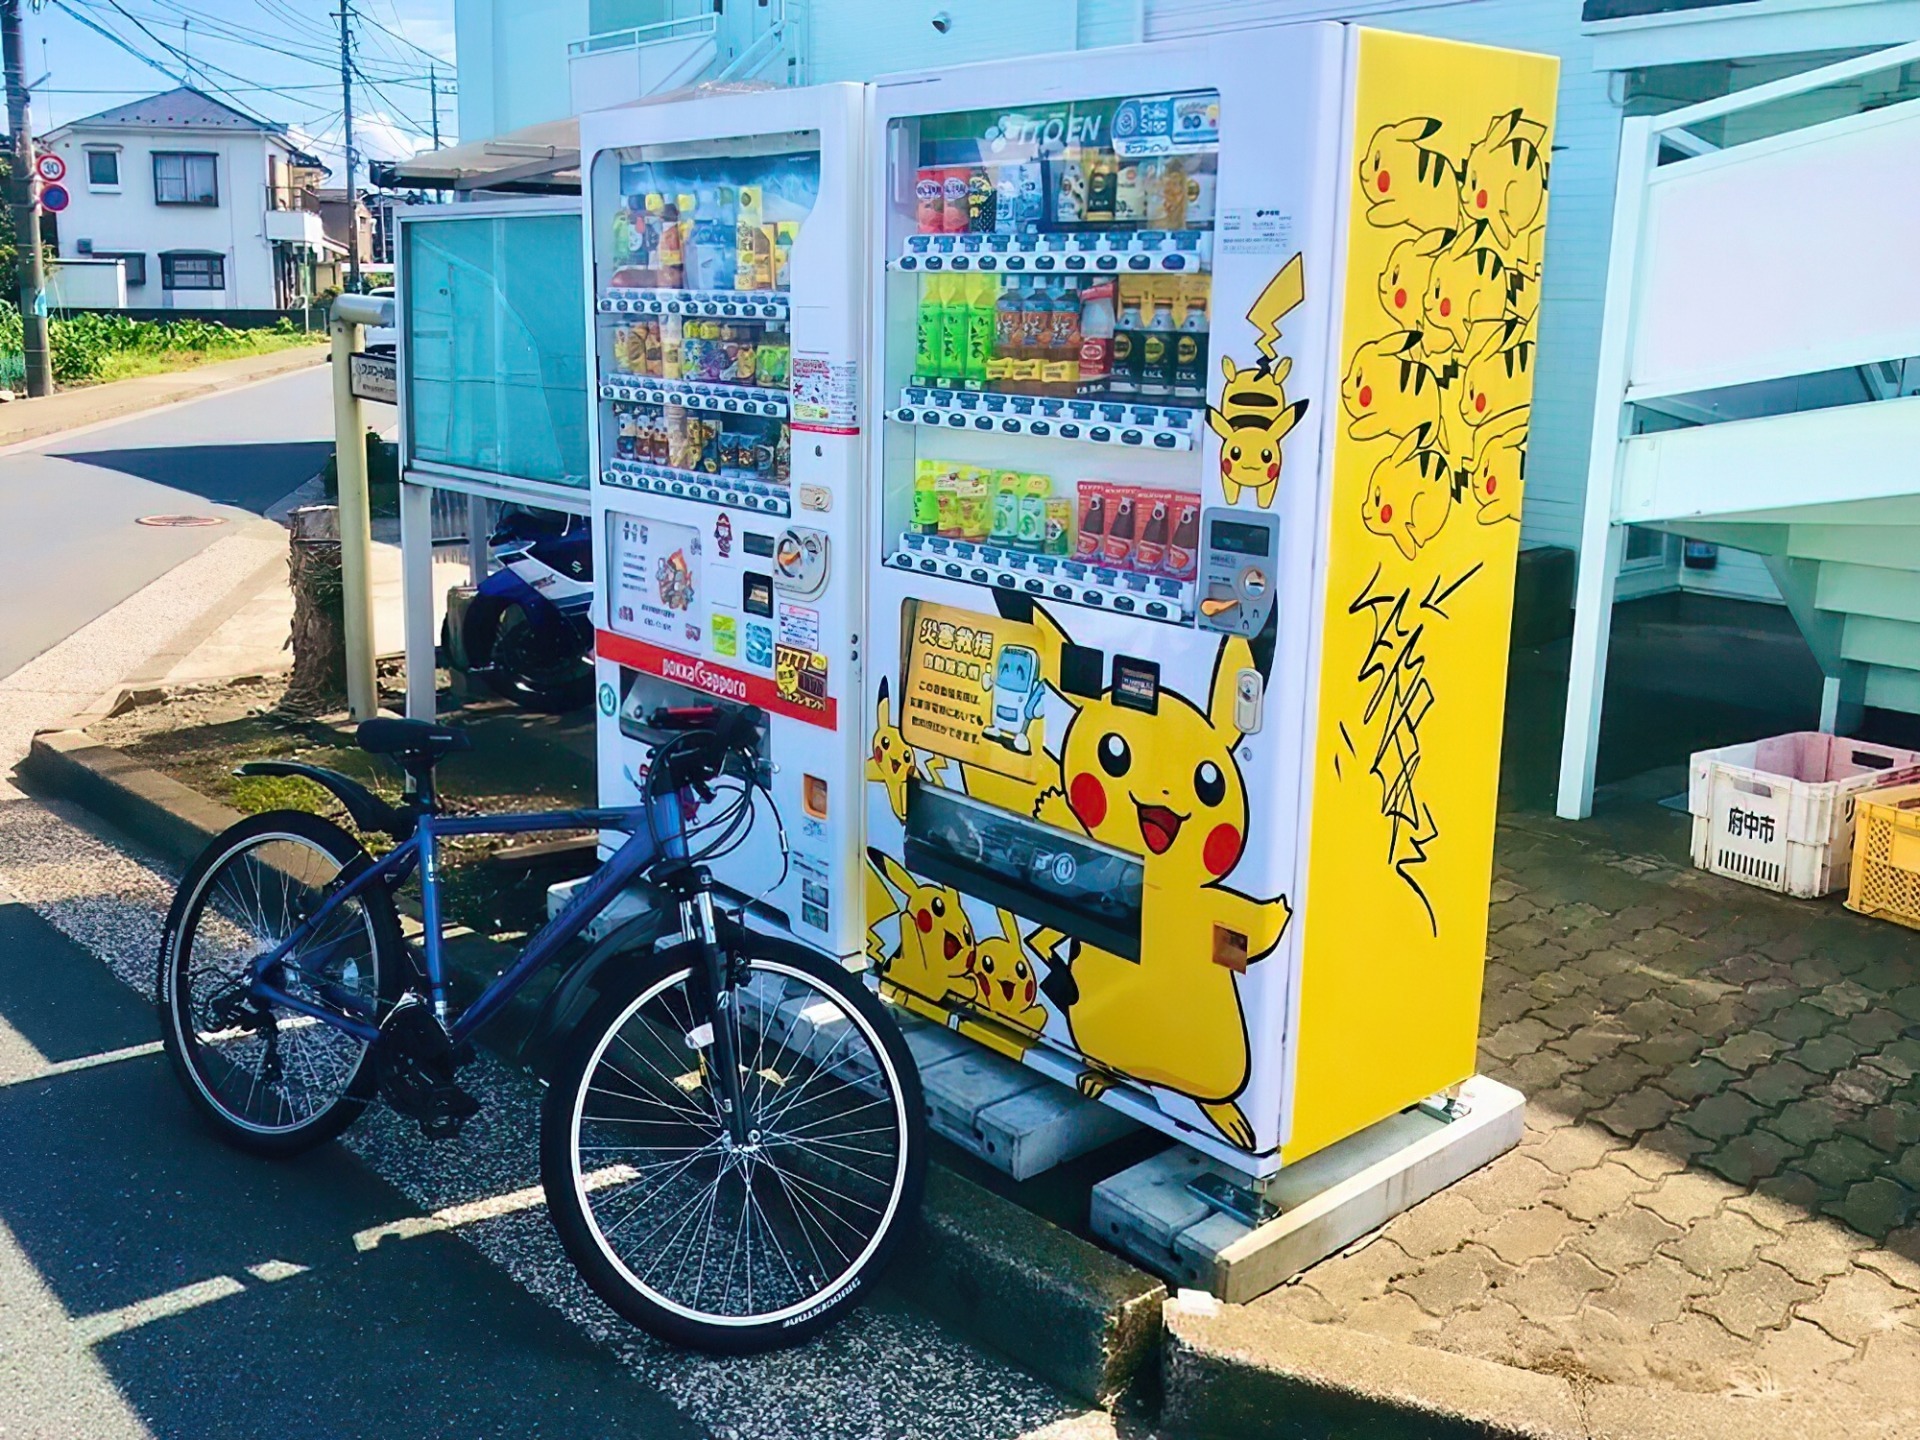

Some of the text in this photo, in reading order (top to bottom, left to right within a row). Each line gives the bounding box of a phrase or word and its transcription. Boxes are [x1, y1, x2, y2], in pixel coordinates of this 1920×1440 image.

[43, 161, 60, 175] 30
[920, 618, 994, 660] 災害救援
[1728, 807, 1776, 844] 府中市
